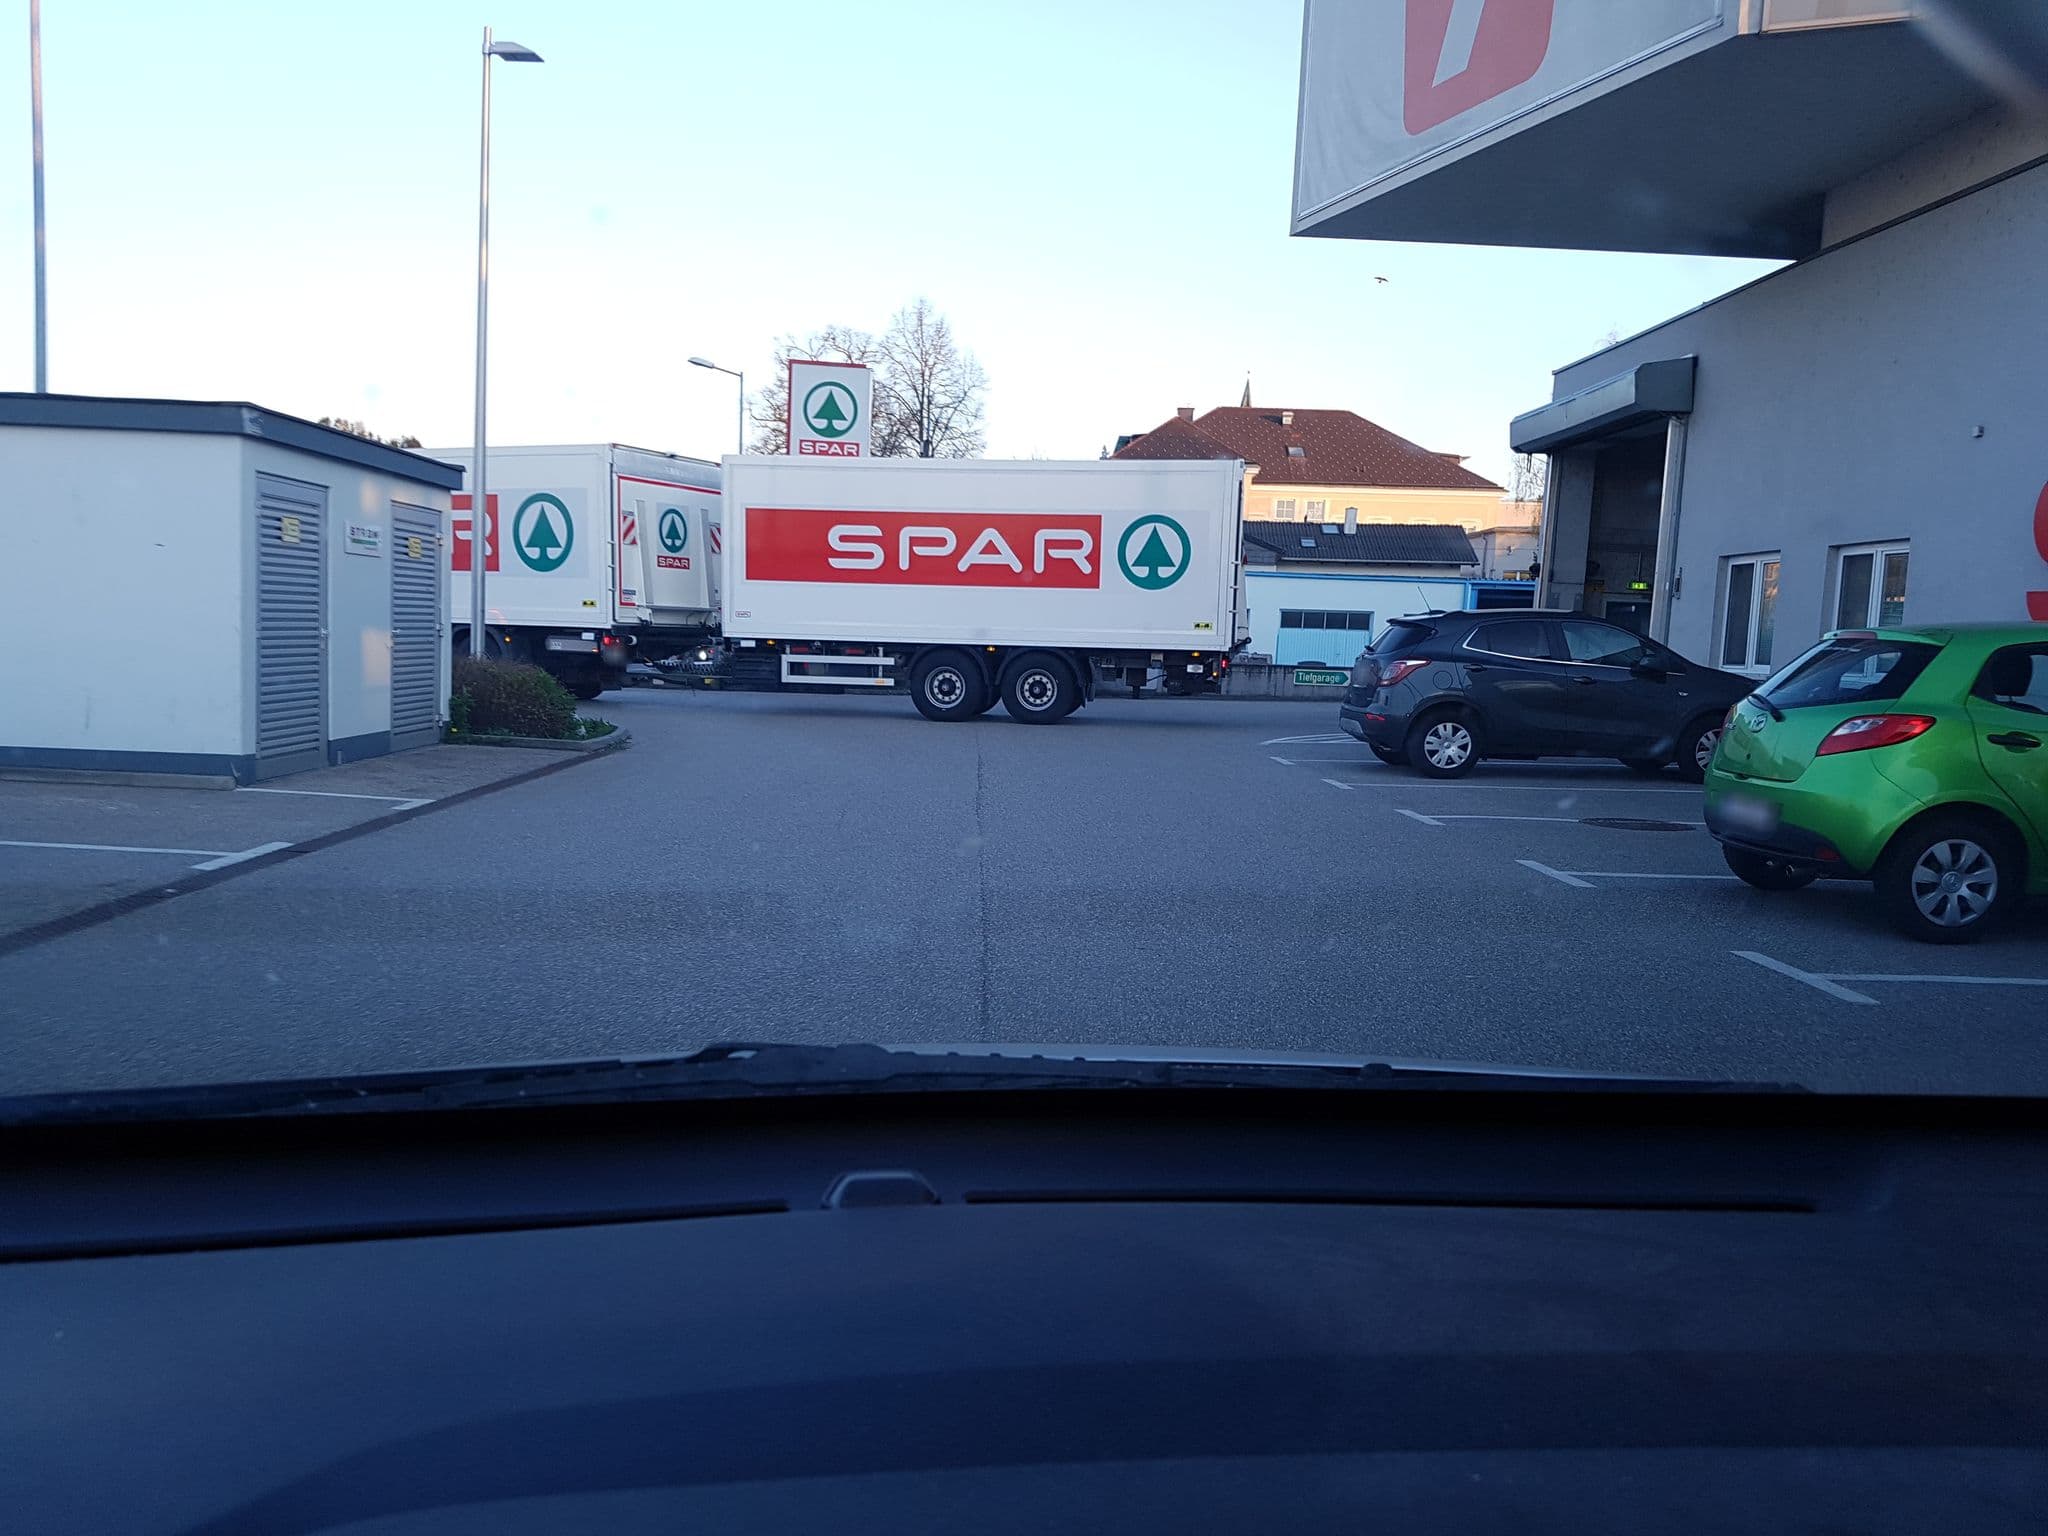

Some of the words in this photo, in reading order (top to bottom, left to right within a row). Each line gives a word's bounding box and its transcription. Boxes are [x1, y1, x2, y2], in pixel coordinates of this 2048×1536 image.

[800, 441, 858, 456] SPAR
[828, 524, 1093, 574] SPAR
[658, 557, 689, 569] SPAR
[1297, 671, 1341, 684] Tiefgarage
